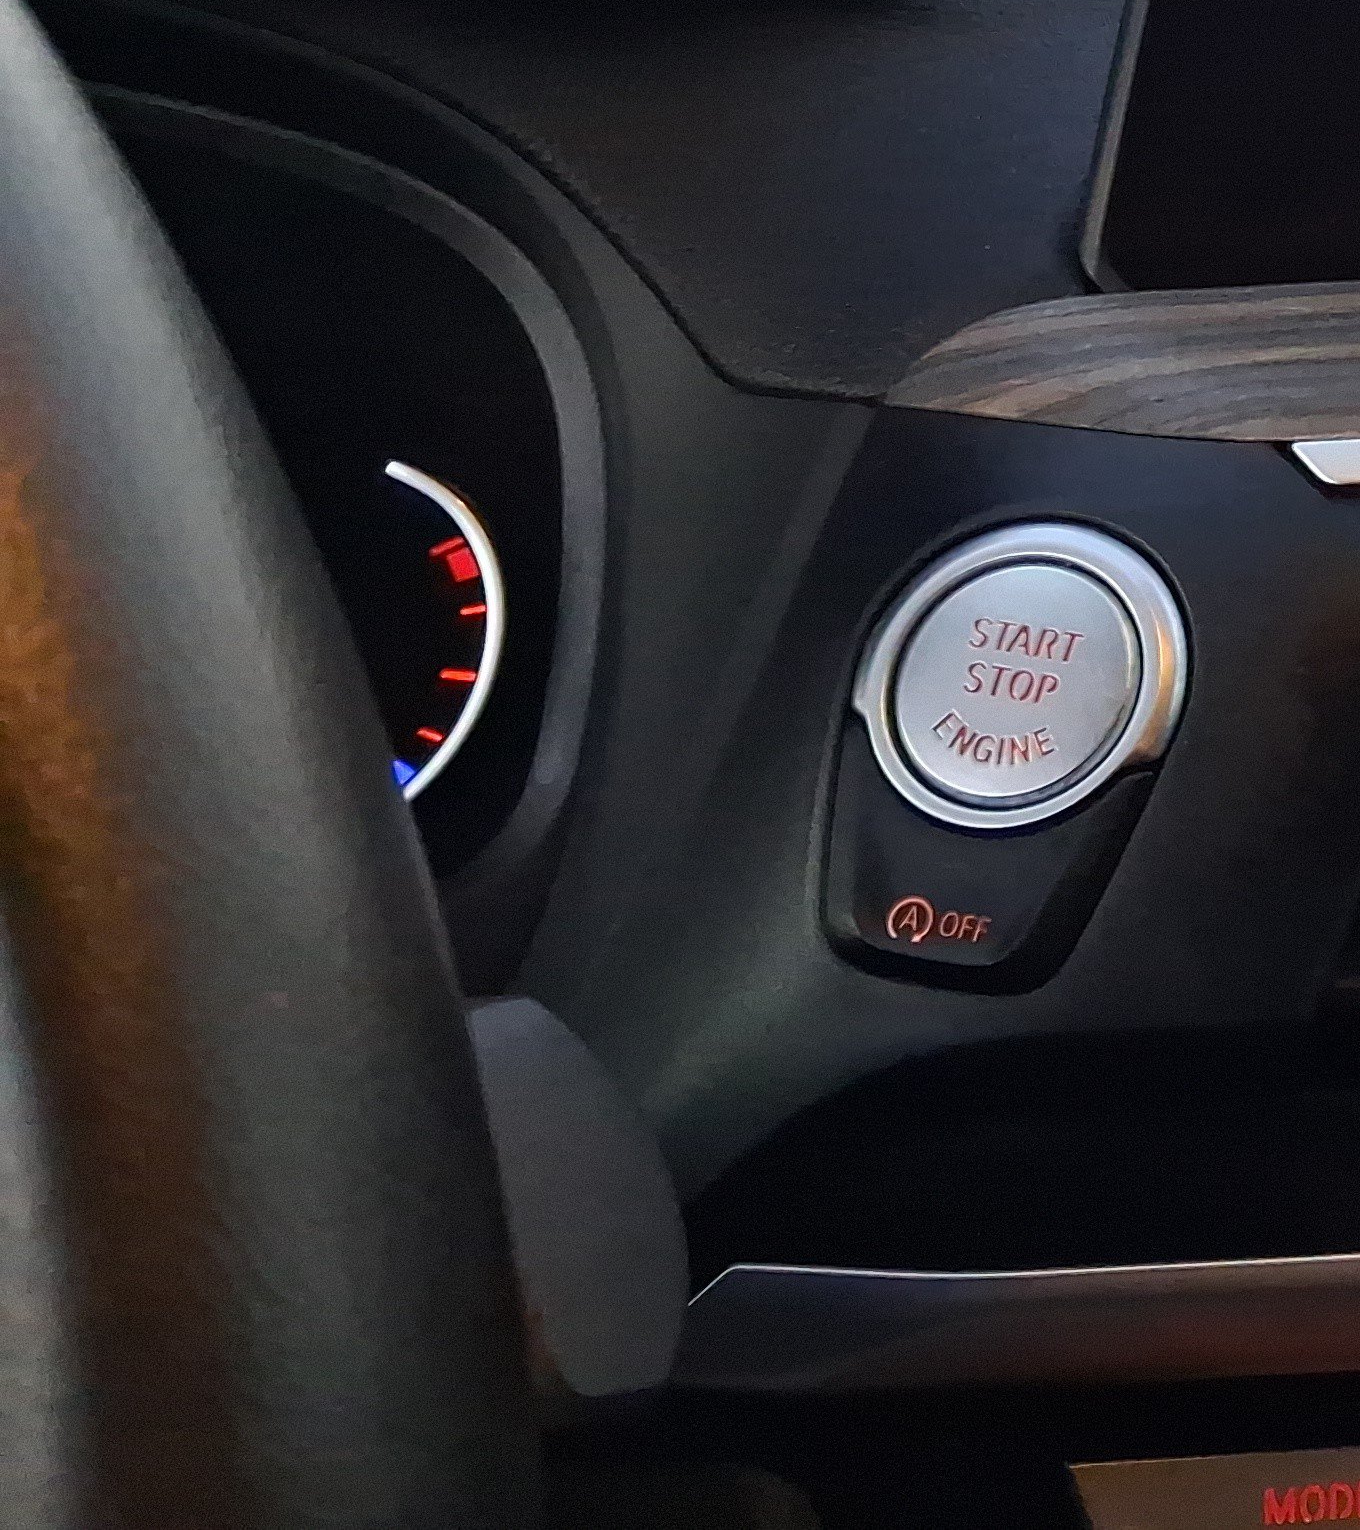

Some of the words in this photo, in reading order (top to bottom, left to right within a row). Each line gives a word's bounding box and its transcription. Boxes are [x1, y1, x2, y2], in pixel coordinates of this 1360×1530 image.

[968, 617, 1085, 662] START
[963, 661, 1061, 705] STOP
[932, 710, 1056, 765] ENGINE
[899, 905, 918, 931] A
[939, 911, 992, 943] OFF
